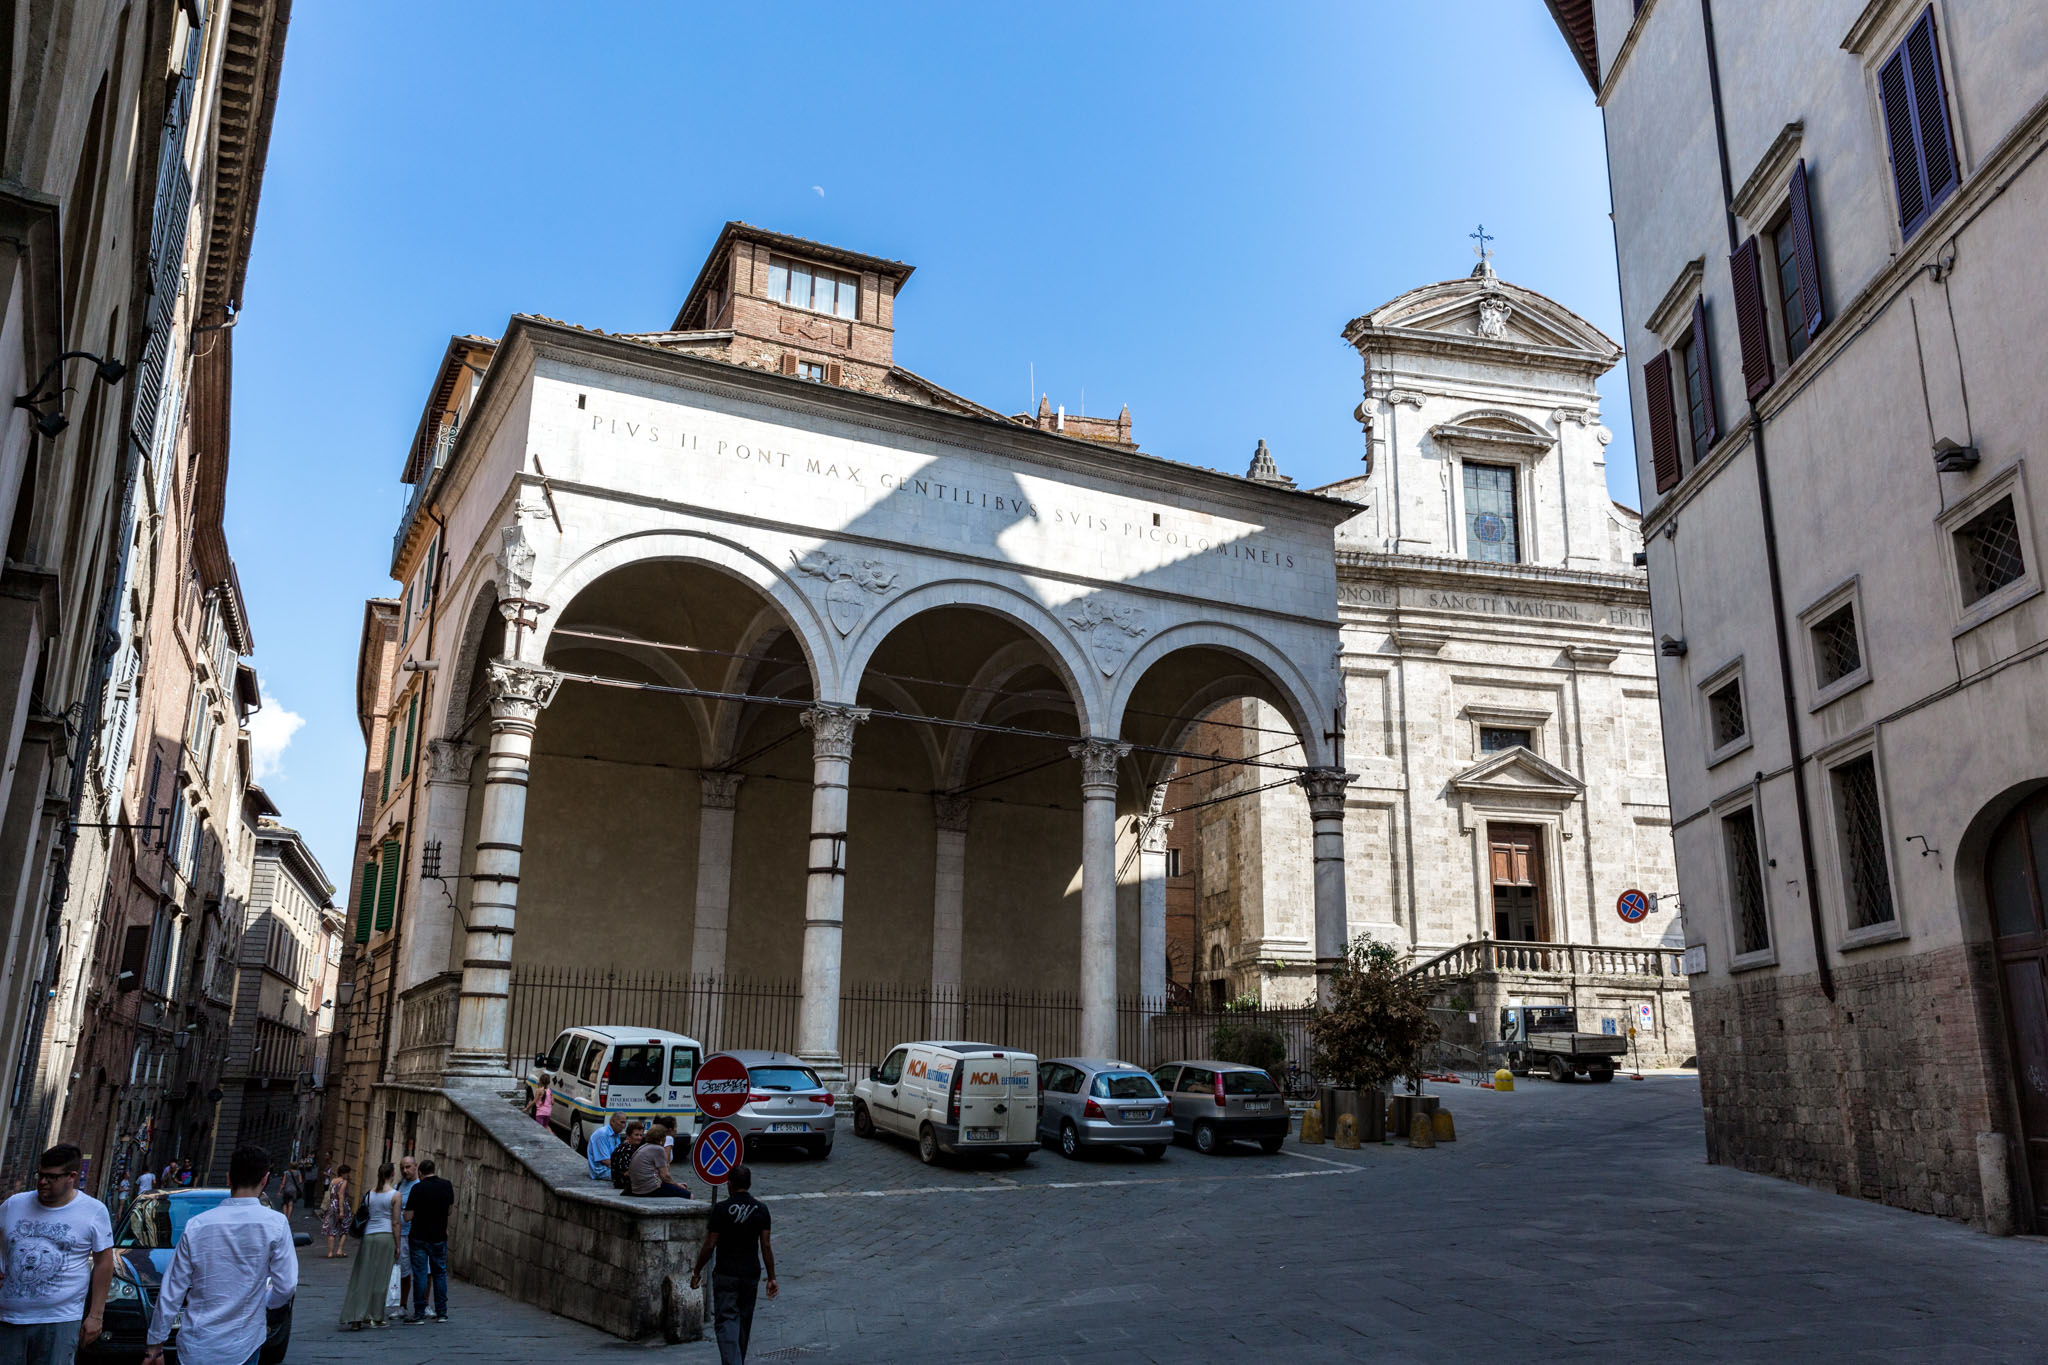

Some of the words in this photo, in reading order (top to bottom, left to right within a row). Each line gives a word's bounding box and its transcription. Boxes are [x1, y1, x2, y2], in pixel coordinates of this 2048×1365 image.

[592, 415, 660, 443] PIVS
[681, 433, 698, 450] II
[717, 440, 791, 468] PONT
[806, 458, 862, 483] MAX
[880, 473, 1038, 518] GENTILIBVS
[1055, 508, 1108, 531] SVIS
[1124, 522, 1296, 569] PICOLOMINEIS
[1429, 593, 1496, 613] SANCTI
[1507, 600, 1578, 620] MARTINI
[907, 1058, 928, 1079] MCM
[970, 1072, 999, 1086] MCM
